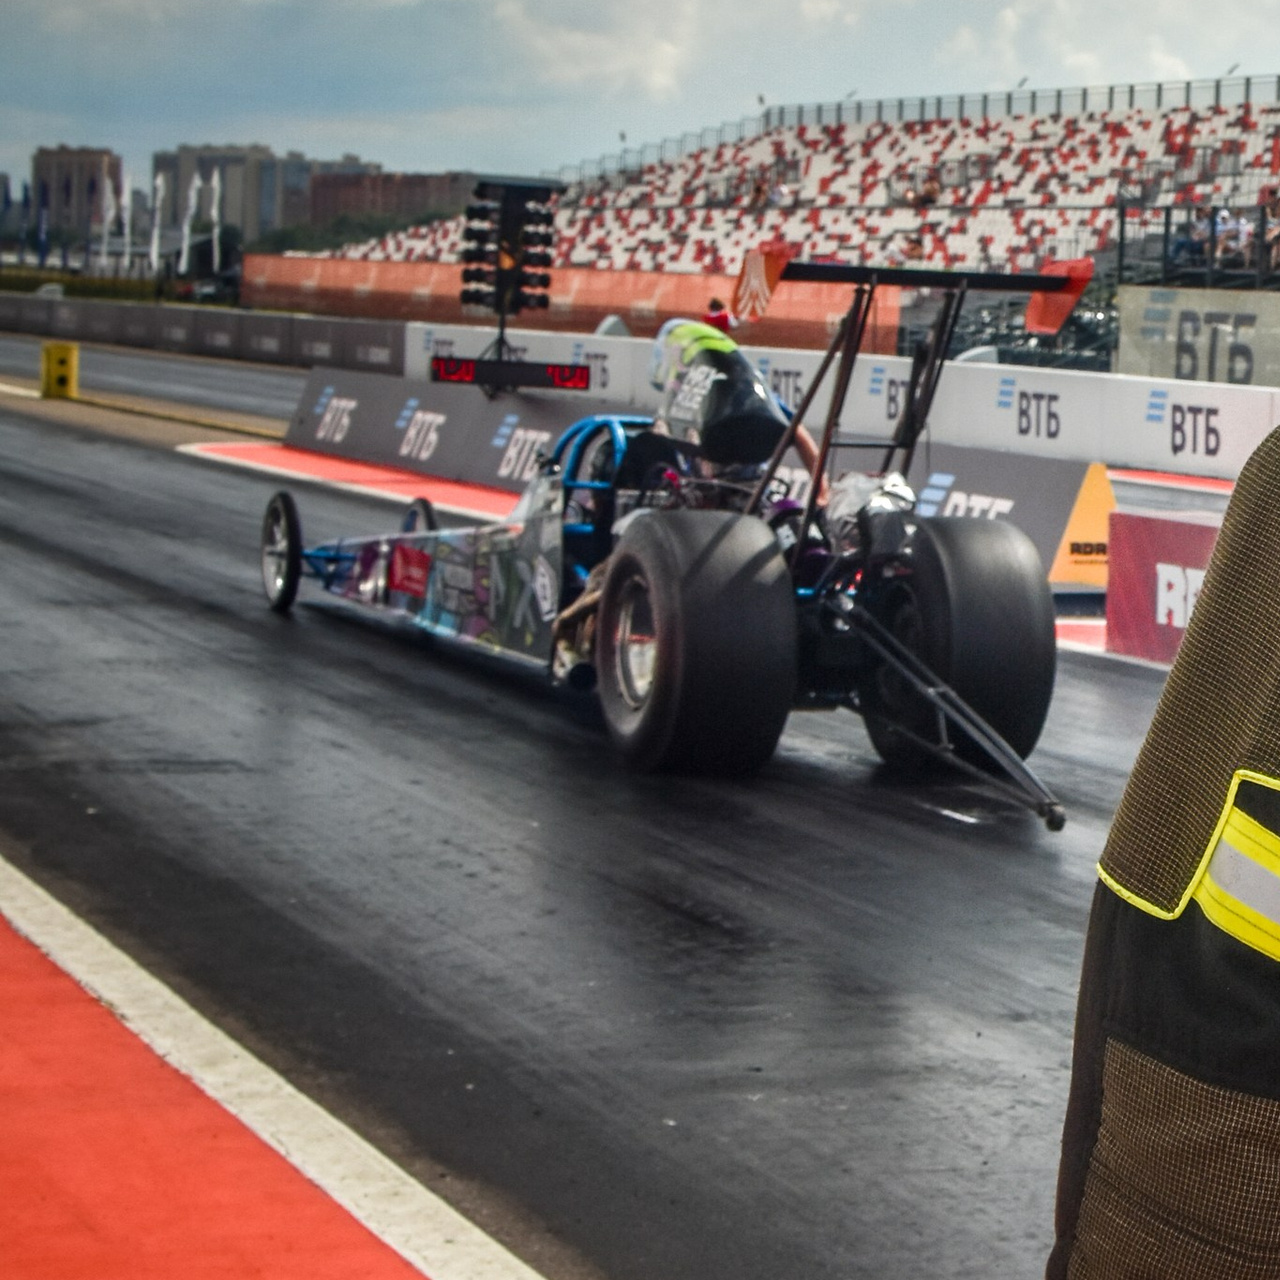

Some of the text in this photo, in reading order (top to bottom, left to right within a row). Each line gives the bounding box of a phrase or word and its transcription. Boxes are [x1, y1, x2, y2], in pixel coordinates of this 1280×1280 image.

[1176, 310, 1257, 385] ВТБ
[399, 409, 447, 461] ВТБ
[1018, 391, 1061, 440] ВТБ
[1171, 404, 1220, 456] ВТБ
